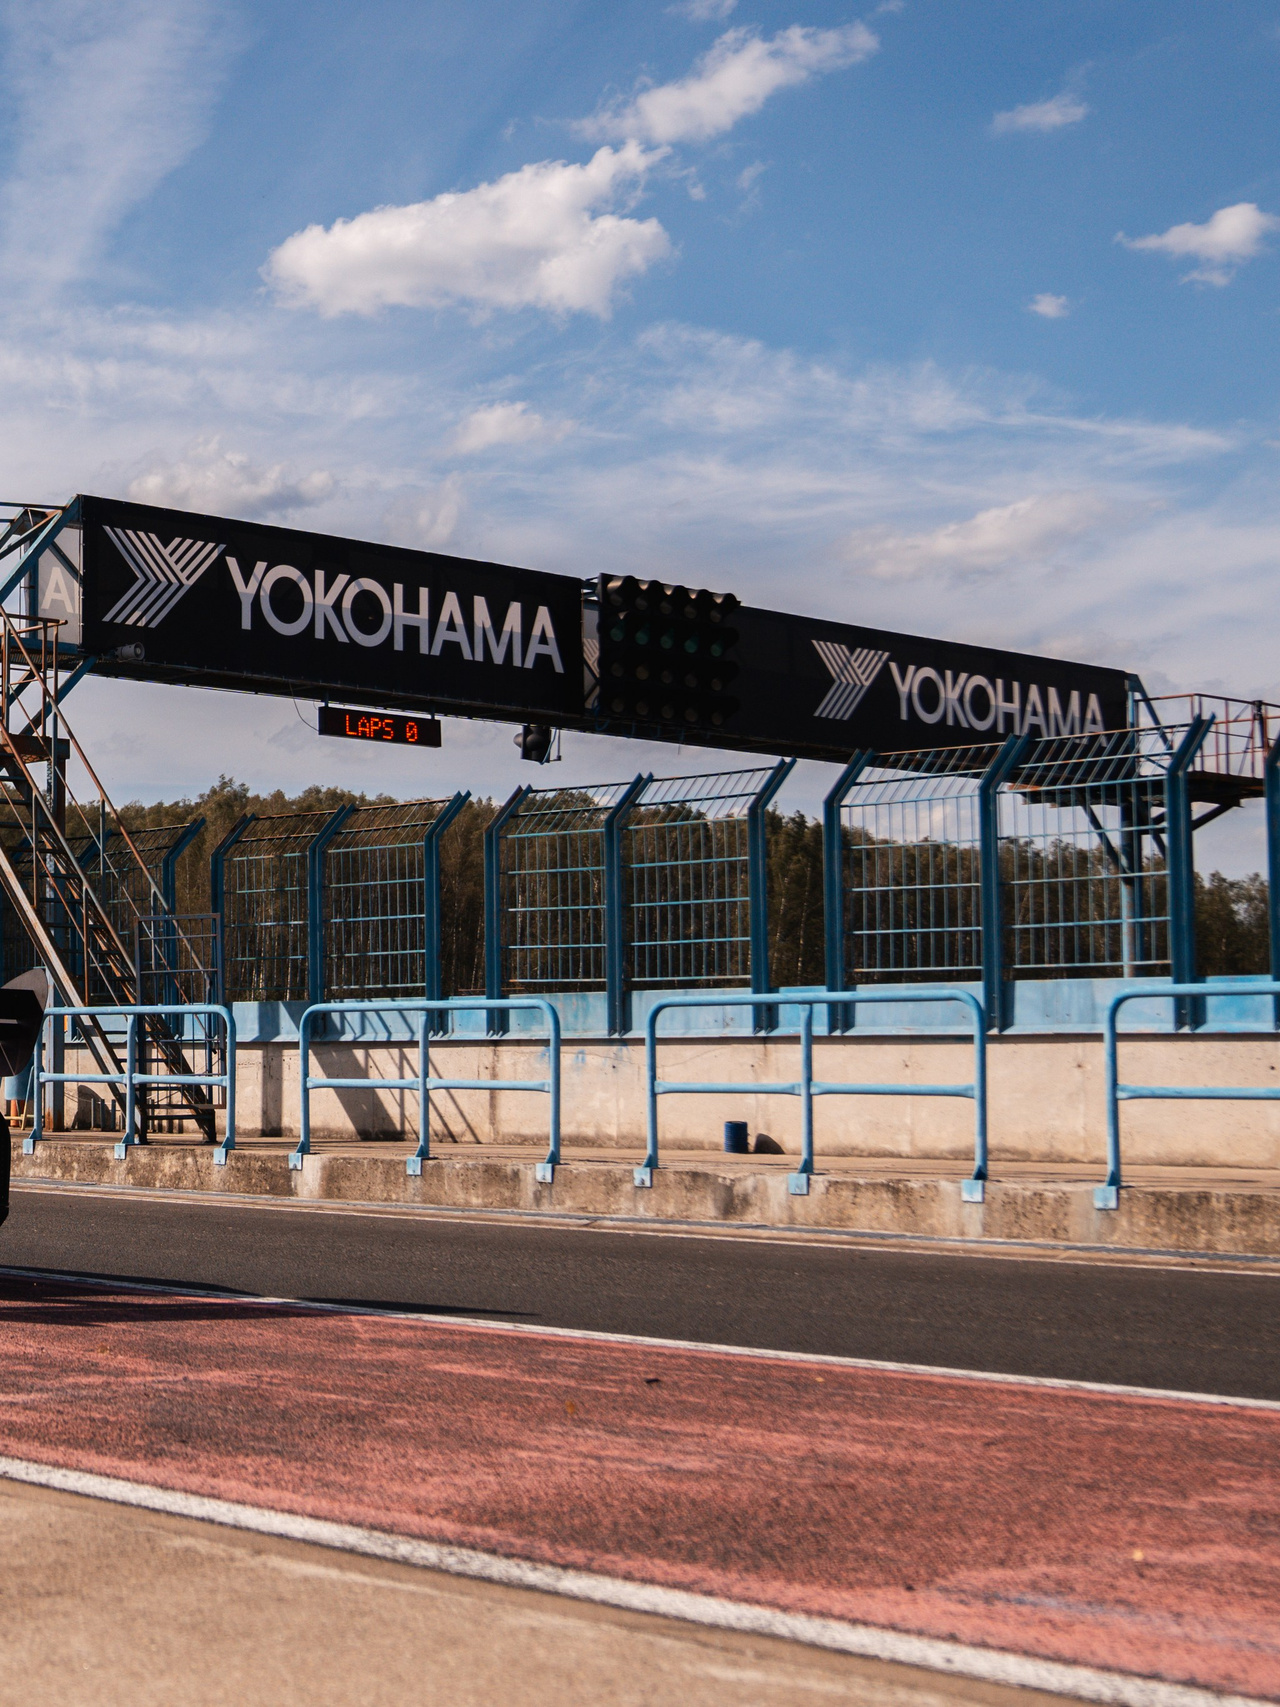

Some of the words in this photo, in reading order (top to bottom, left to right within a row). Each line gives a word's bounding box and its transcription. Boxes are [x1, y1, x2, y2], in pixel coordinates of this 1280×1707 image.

[225, 556, 564, 674] YOKOHAMA
[345, 714, 394, 740] LAPS
[405, 721, 418, 742] 0
[888, 661, 1109, 747] YOKOHAMA
